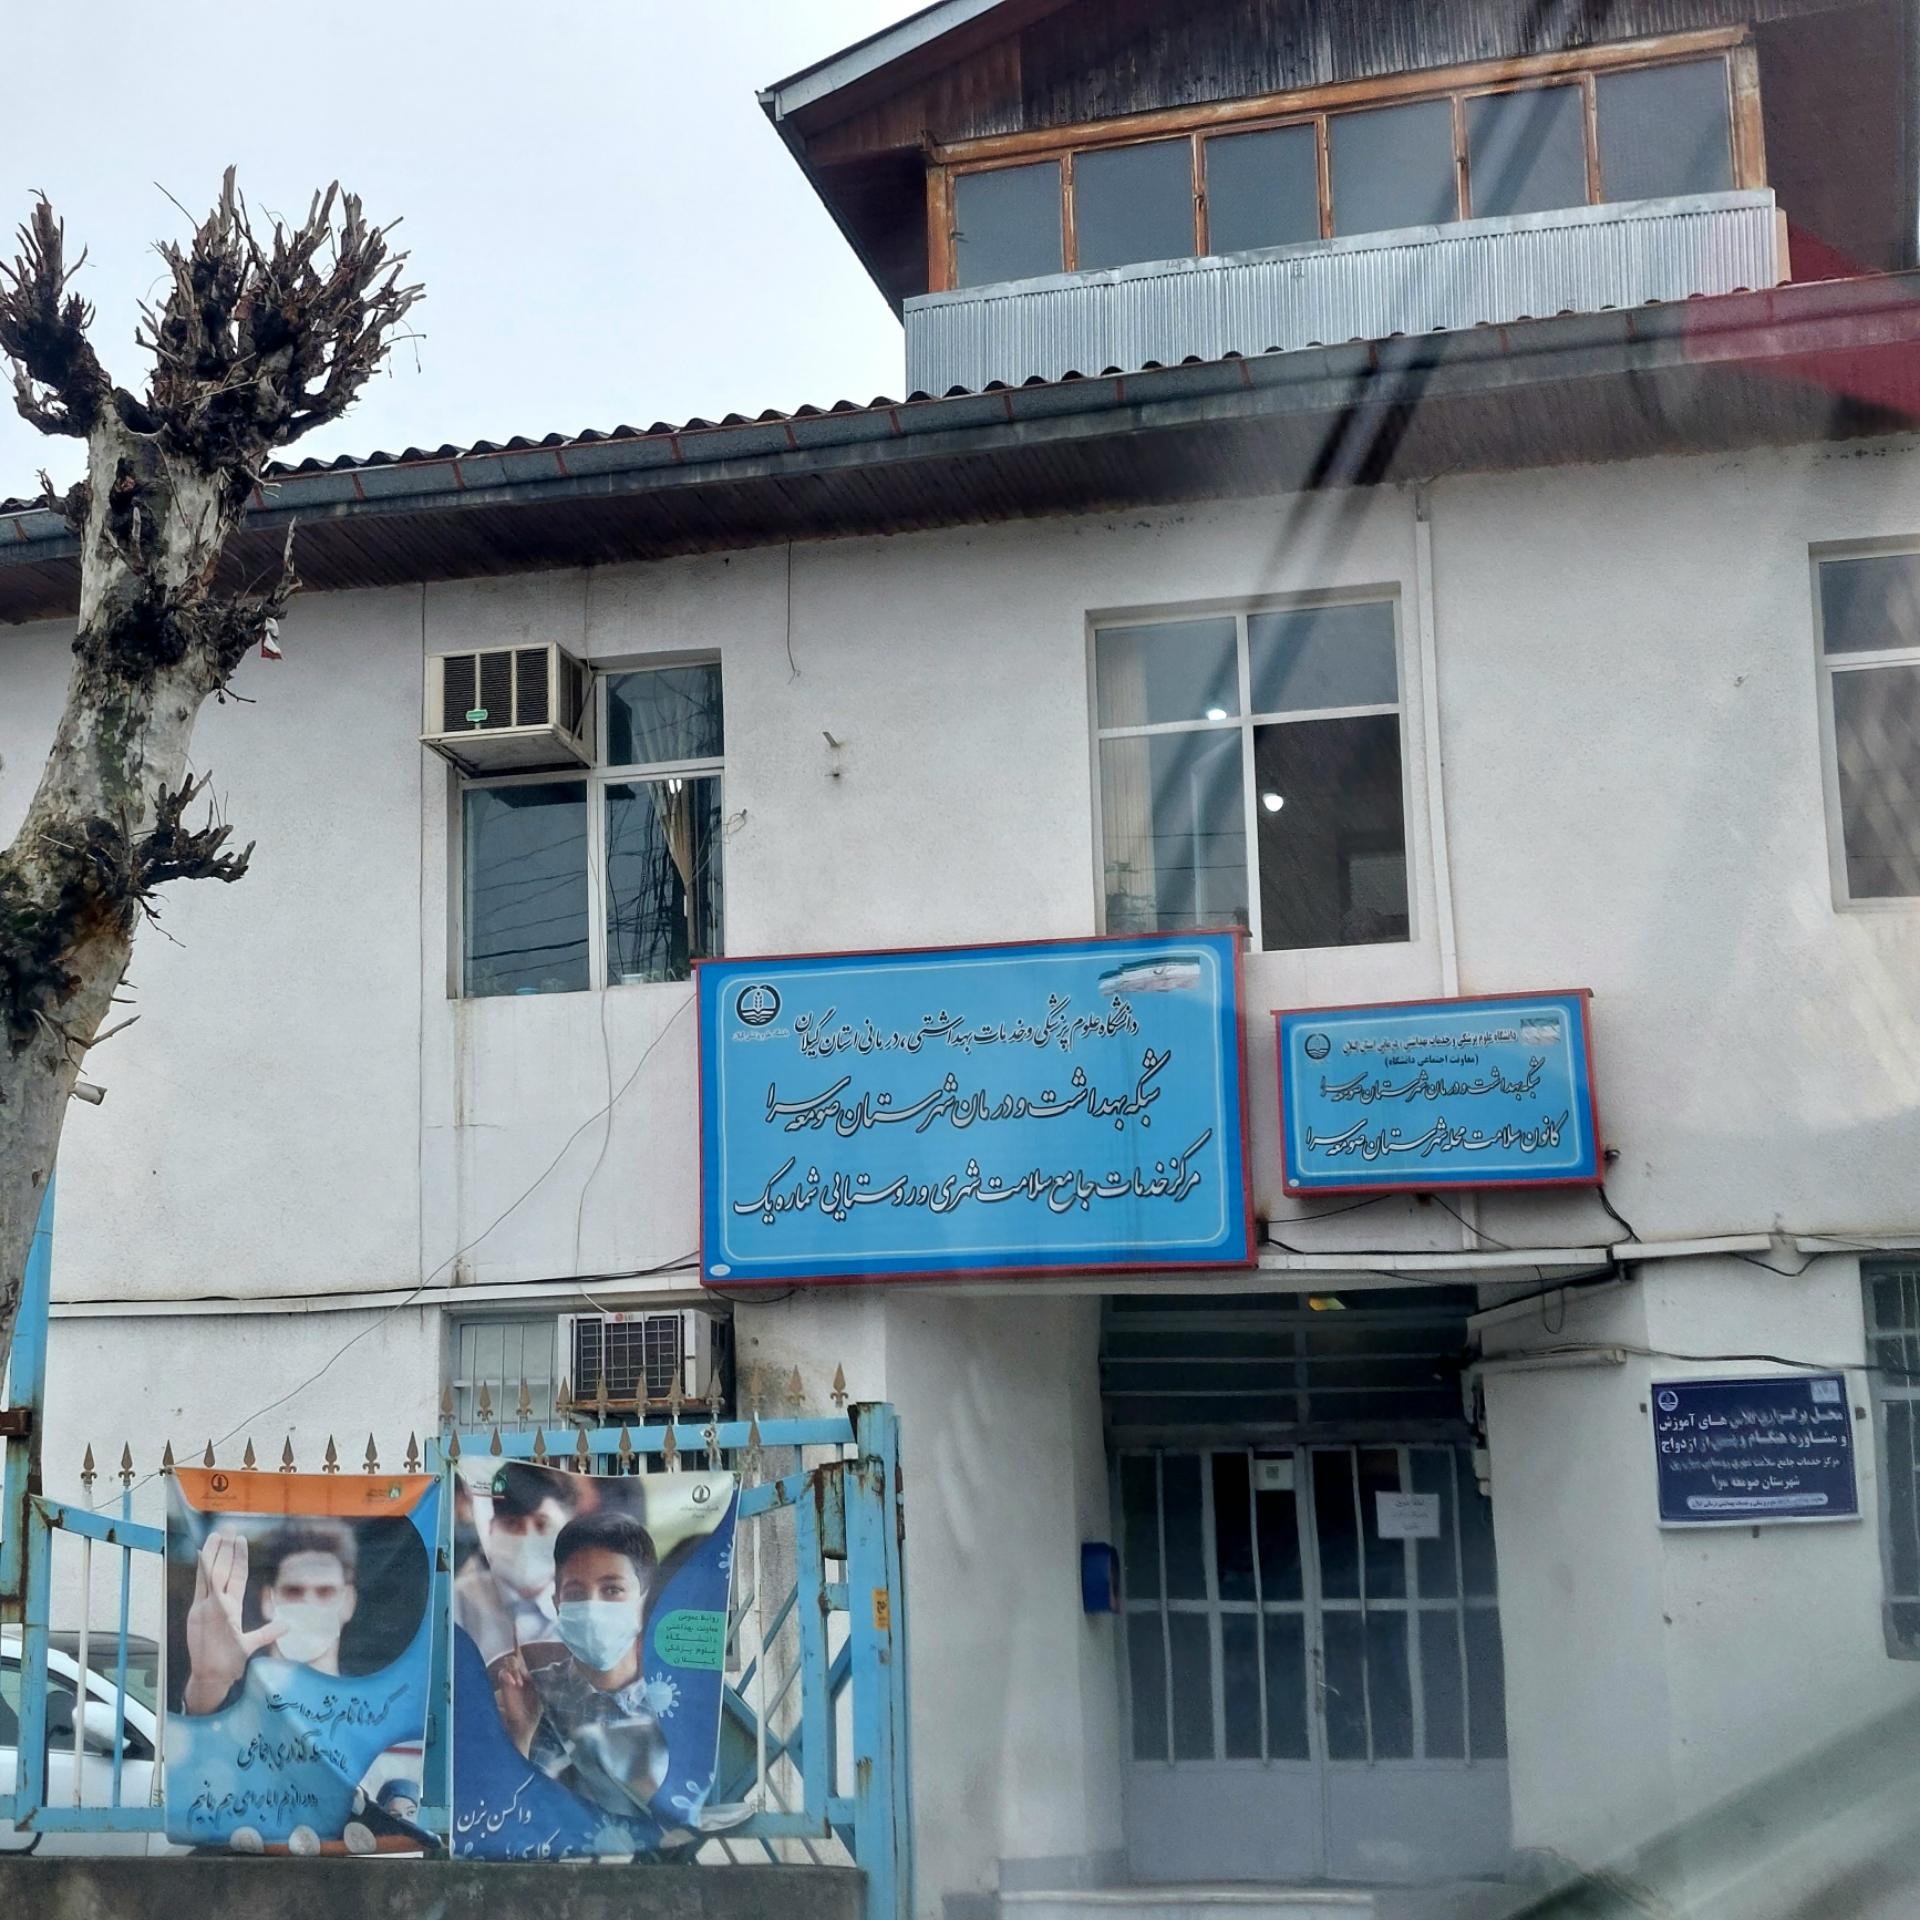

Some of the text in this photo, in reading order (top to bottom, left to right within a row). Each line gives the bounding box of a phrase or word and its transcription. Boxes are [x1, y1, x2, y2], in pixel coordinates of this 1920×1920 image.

[794, 1005, 837, 1060] گیلان
[857, 1017, 900, 1055] درمانی
[973, 1018, 1027, 1045] خدمات
[1033, 993, 1071, 1052] پزشکی
[1070, 1012, 1101, 1052] علوم
[1099, 995, 1139, 1037] دانشگاه
[818, 1024, 859, 1058] استان
[1123, 1047, 1172, 1128] شبکه
[1360, 1069, 1429, 1105] شهرستان
[1423, 1078, 1460, 1100] درمان
[1466, 1065, 1522, 1101] بهداشت
[1520, 1055, 1545, 1099] شبکه
[835, 1072, 959, 1138] شهرستان
[950, 1088, 1013, 1129] درمان
[1027, 1066, 1128, 1132] بهداشت
[1361, 1116, 1448, 1161] شهرستان
[1441, 1126, 1467, 1152] محله
[1463, 1123, 1522, 1150] سلامت
[1521, 1110, 1569, 1153] کانون
[928, 1157, 982, 1213] شهری
[975, 1167, 1053, 1202] سلامت
[1094, 1160, 1169, 1198] خدمات
[1165, 1127, 1213, 1202] مرکز
[733, 1155, 796, 1225] یک
[773, 1165, 819, 1212] شماره
[819, 1170, 917, 1222] روستایی
[1048, 1168, 1095, 1214] جامع
[1659, 1412, 1696, 1431] آموزش
[1810, 1405, 1843, 1425] محل
[1661, 1436, 1698, 1454] ازدواج
[1787, 1429, 1838, 1448] مشاوره
[1761, 1474, 1800, 1490] شهرستان
[457, 1772, 533, 1838] واکسن بزن
